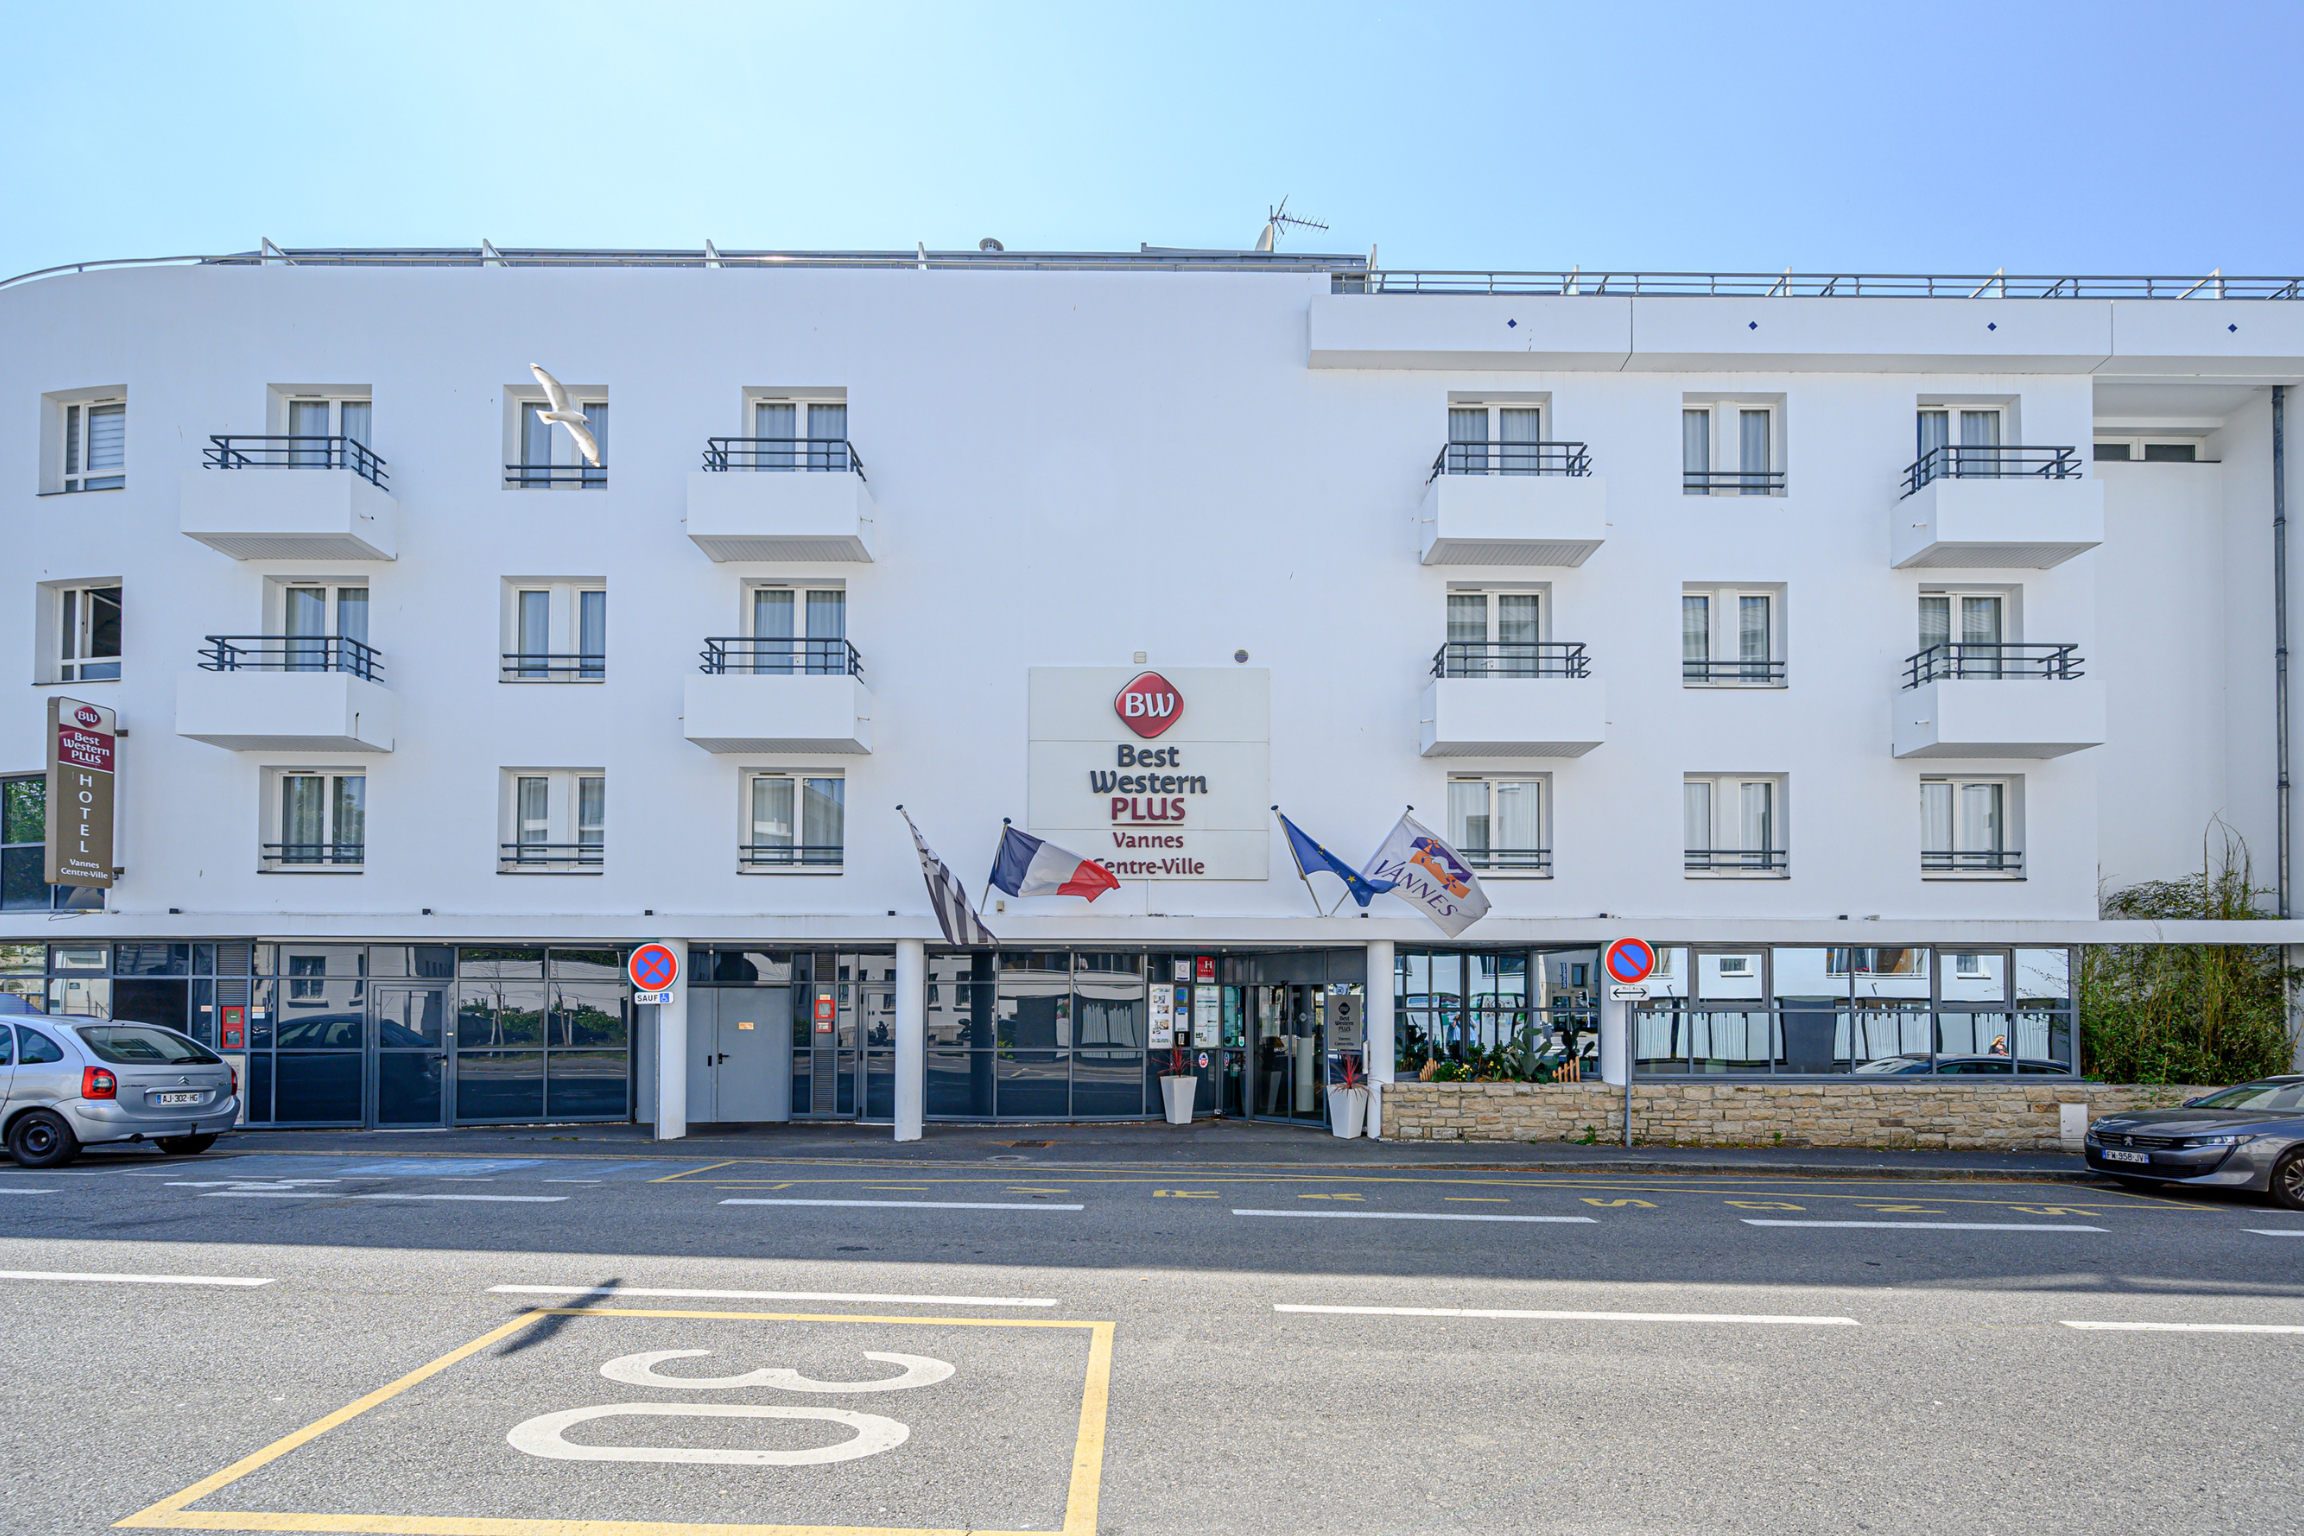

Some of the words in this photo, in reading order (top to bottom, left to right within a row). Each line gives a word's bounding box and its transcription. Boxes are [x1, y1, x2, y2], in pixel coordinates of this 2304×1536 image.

[1125, 692, 1176, 718] BW
[77, 710, 98, 723] BW
[63, 738, 110, 757] Western
[74, 732, 100, 746] Best
[71, 749, 102, 764] PLUS
[1117, 743, 1181, 768] Best
[1089, 770, 1209, 795] Western
[78, 773, 93, 853] HOTEL
[1111, 797, 1187, 822] PLUS
[1112, 831, 1185, 849] Vannes
[69, 858, 100, 869] Vannes
[60, 867, 109, 879] Centre-Ville
[1373, 859, 1459, 917] VANNES
[1204, 960, 1213, 969] H
[637, 994, 659, 1002] SAUF
